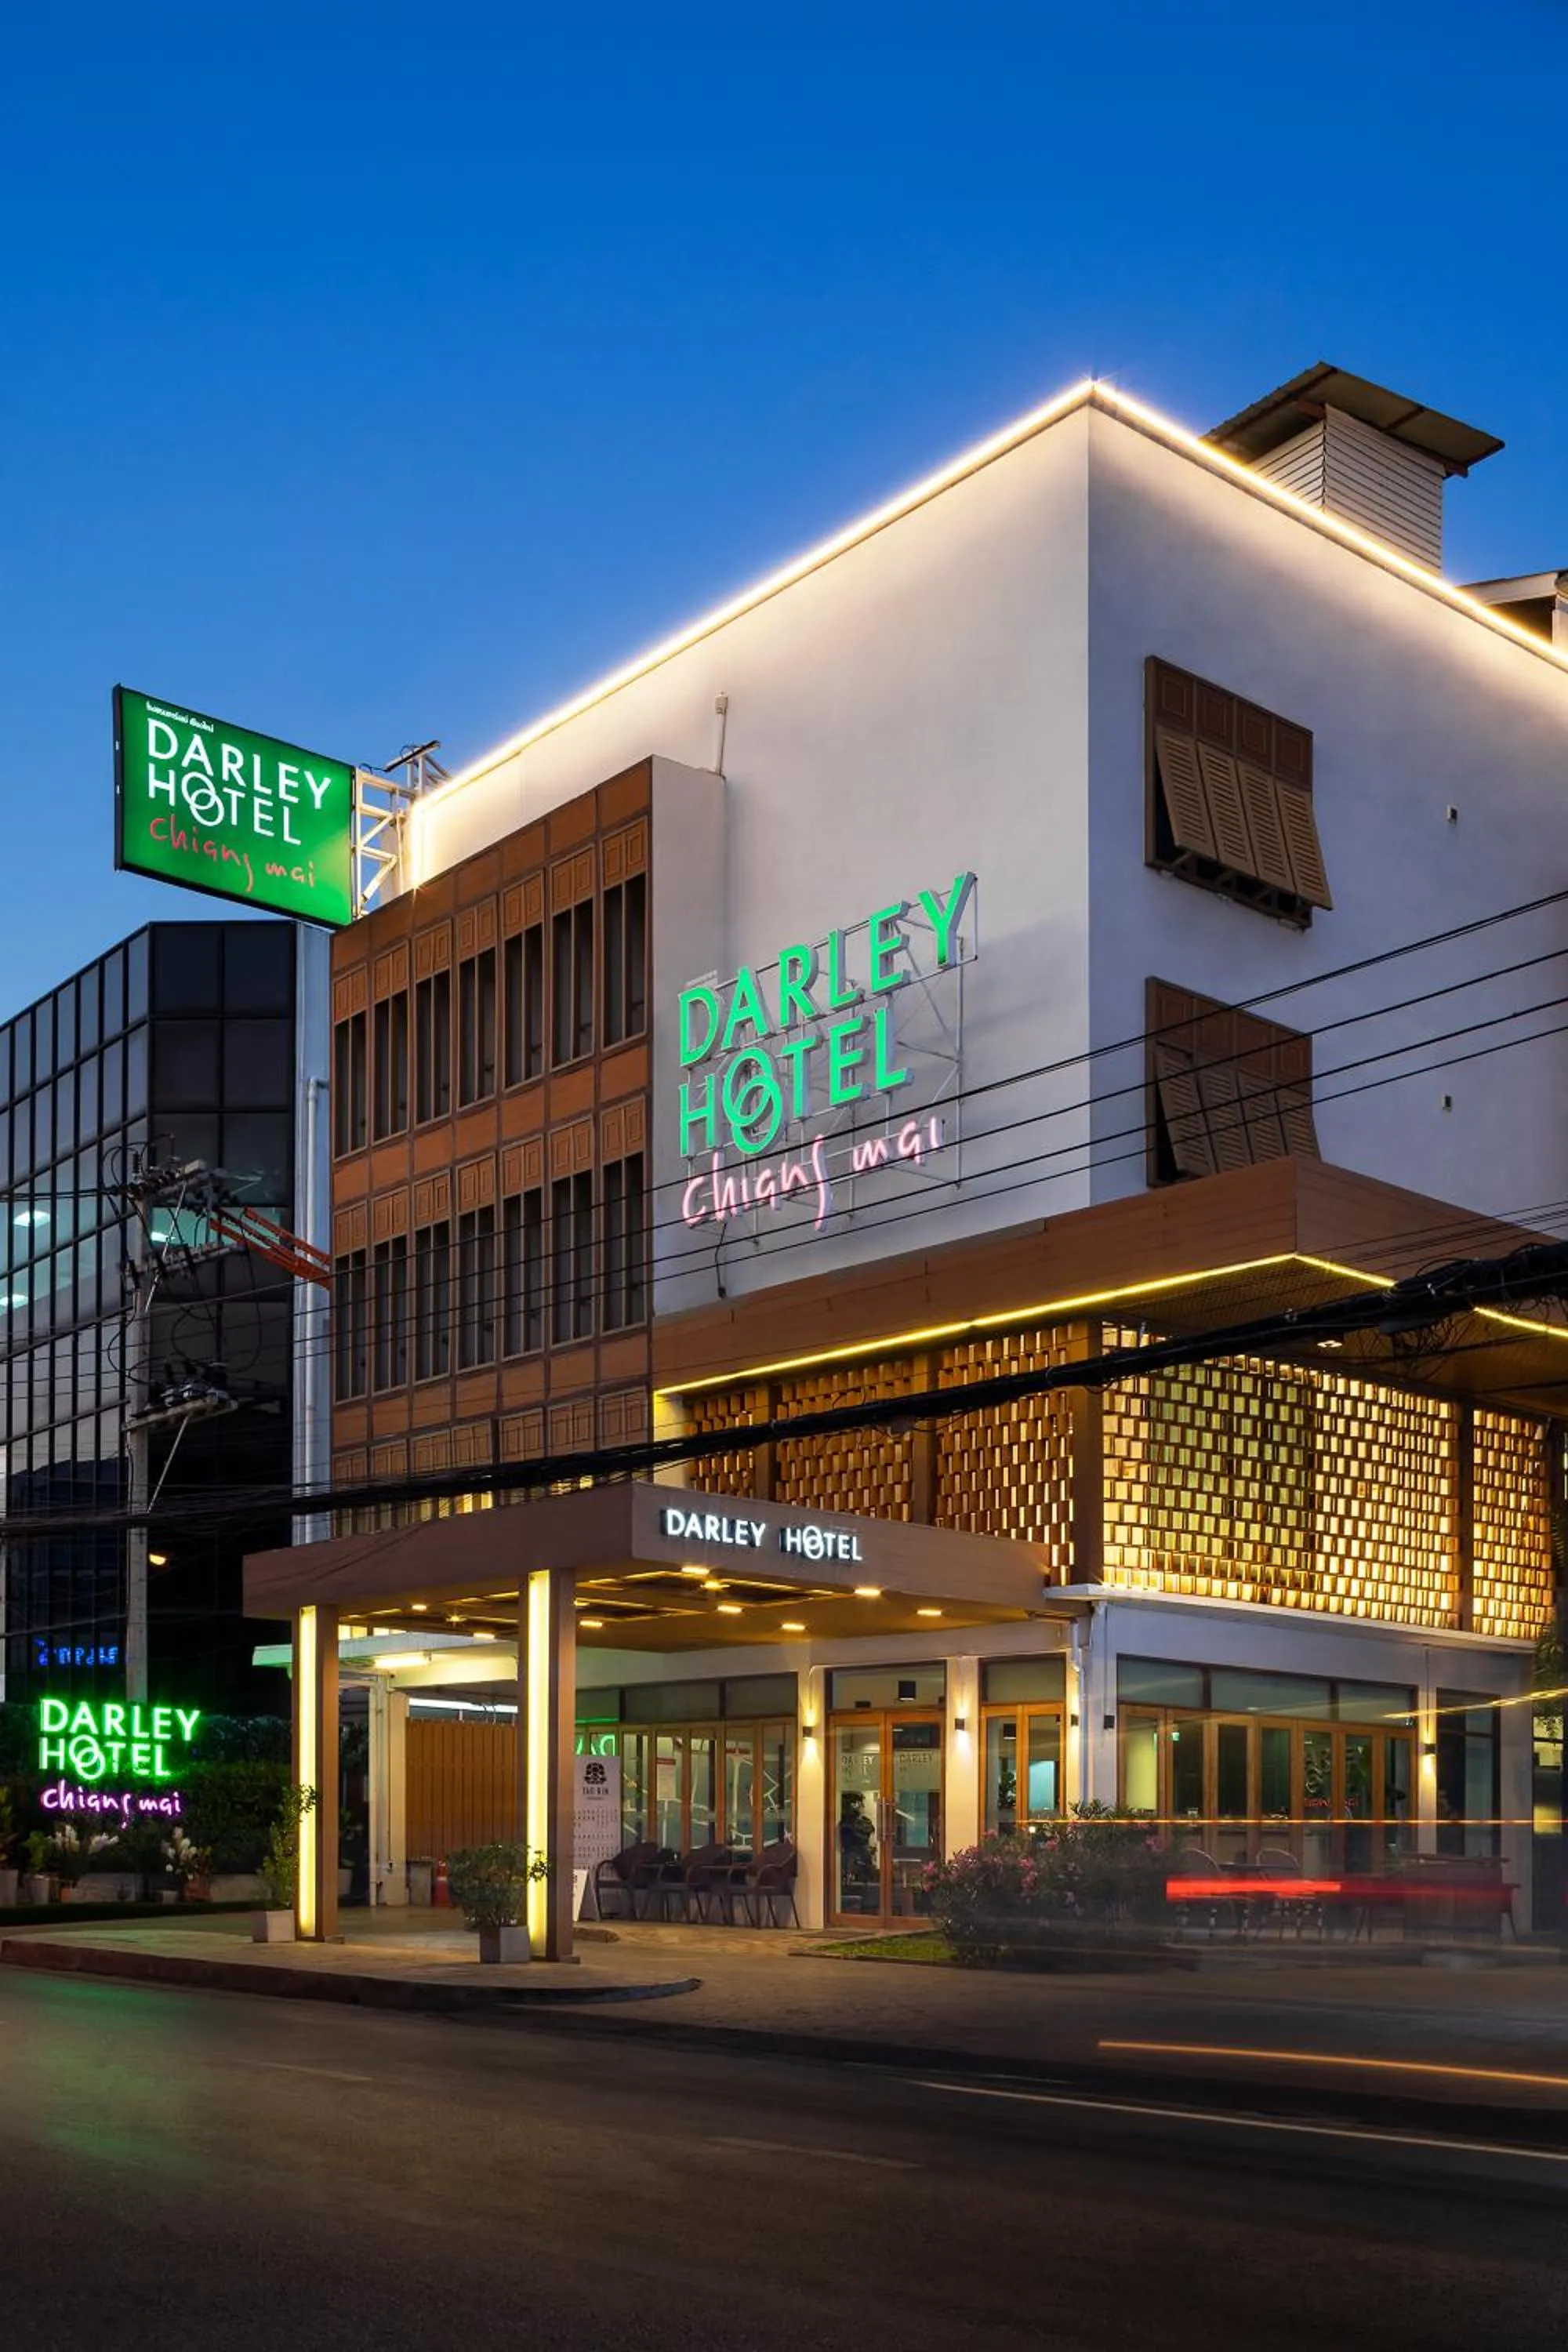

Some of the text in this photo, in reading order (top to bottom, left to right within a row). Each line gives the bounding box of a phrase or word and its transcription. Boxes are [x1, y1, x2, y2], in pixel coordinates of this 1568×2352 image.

[147, 717, 332, 809] DARLEY
[148, 762, 301, 845] HOTEL
[265, 861, 314, 887] mai
[678, 872, 975, 1067] DARLEY
[678, 1007, 912, 1157] HOTEL
[851, 1116, 943, 1167] mai
[666, 1508, 863, 1561] DARLEY HOTEL
[40, 1698, 201, 1741] DARLEY
[40, 1734, 172, 1780] HOTEL
[138, 1791, 182, 1816] mai
